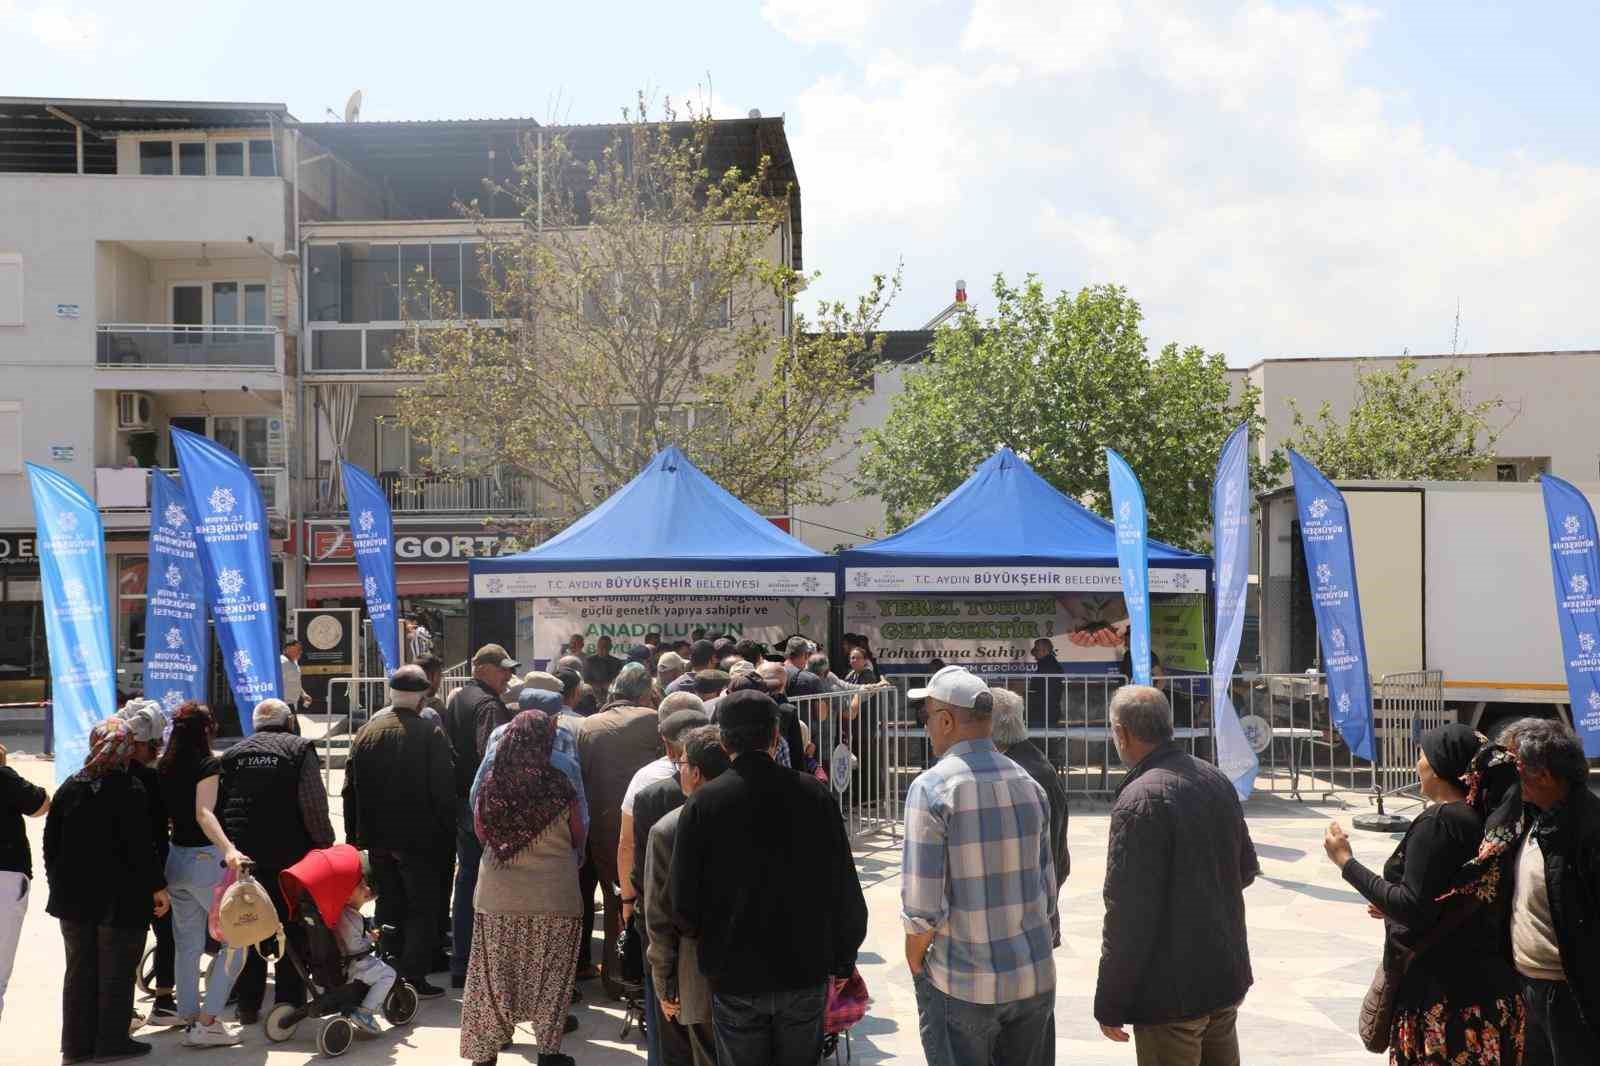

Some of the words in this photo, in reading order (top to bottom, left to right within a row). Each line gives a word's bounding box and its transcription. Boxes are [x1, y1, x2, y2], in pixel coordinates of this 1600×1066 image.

[547, 580, 567, 590] T.C.
[568, 580, 603, 590] AYDIN
[605, 576, 692, 590] BÜYÜKŞEHİR
[696, 578, 760, 590] BELEDİYESİ
[936, 575, 970, 585] AYDIN
[974, 571, 1061, 586] BÜYÜKŞEHİR
[581, 605, 613, 617] güçlü
[616, 605, 661, 617] genetik
[664, 607, 702, 617] yapıya
[705, 605, 751, 617] sahiptir
[754, 606, 769, 615] ve
[876, 599, 960, 616] YEREL
[964, 599, 1056, 616] TOHUM
[879, 618, 1041, 640] GELECEKTİR
[877, 646, 971, 659] Tohumuna
[975, 645, 1026, 660] Sahip
